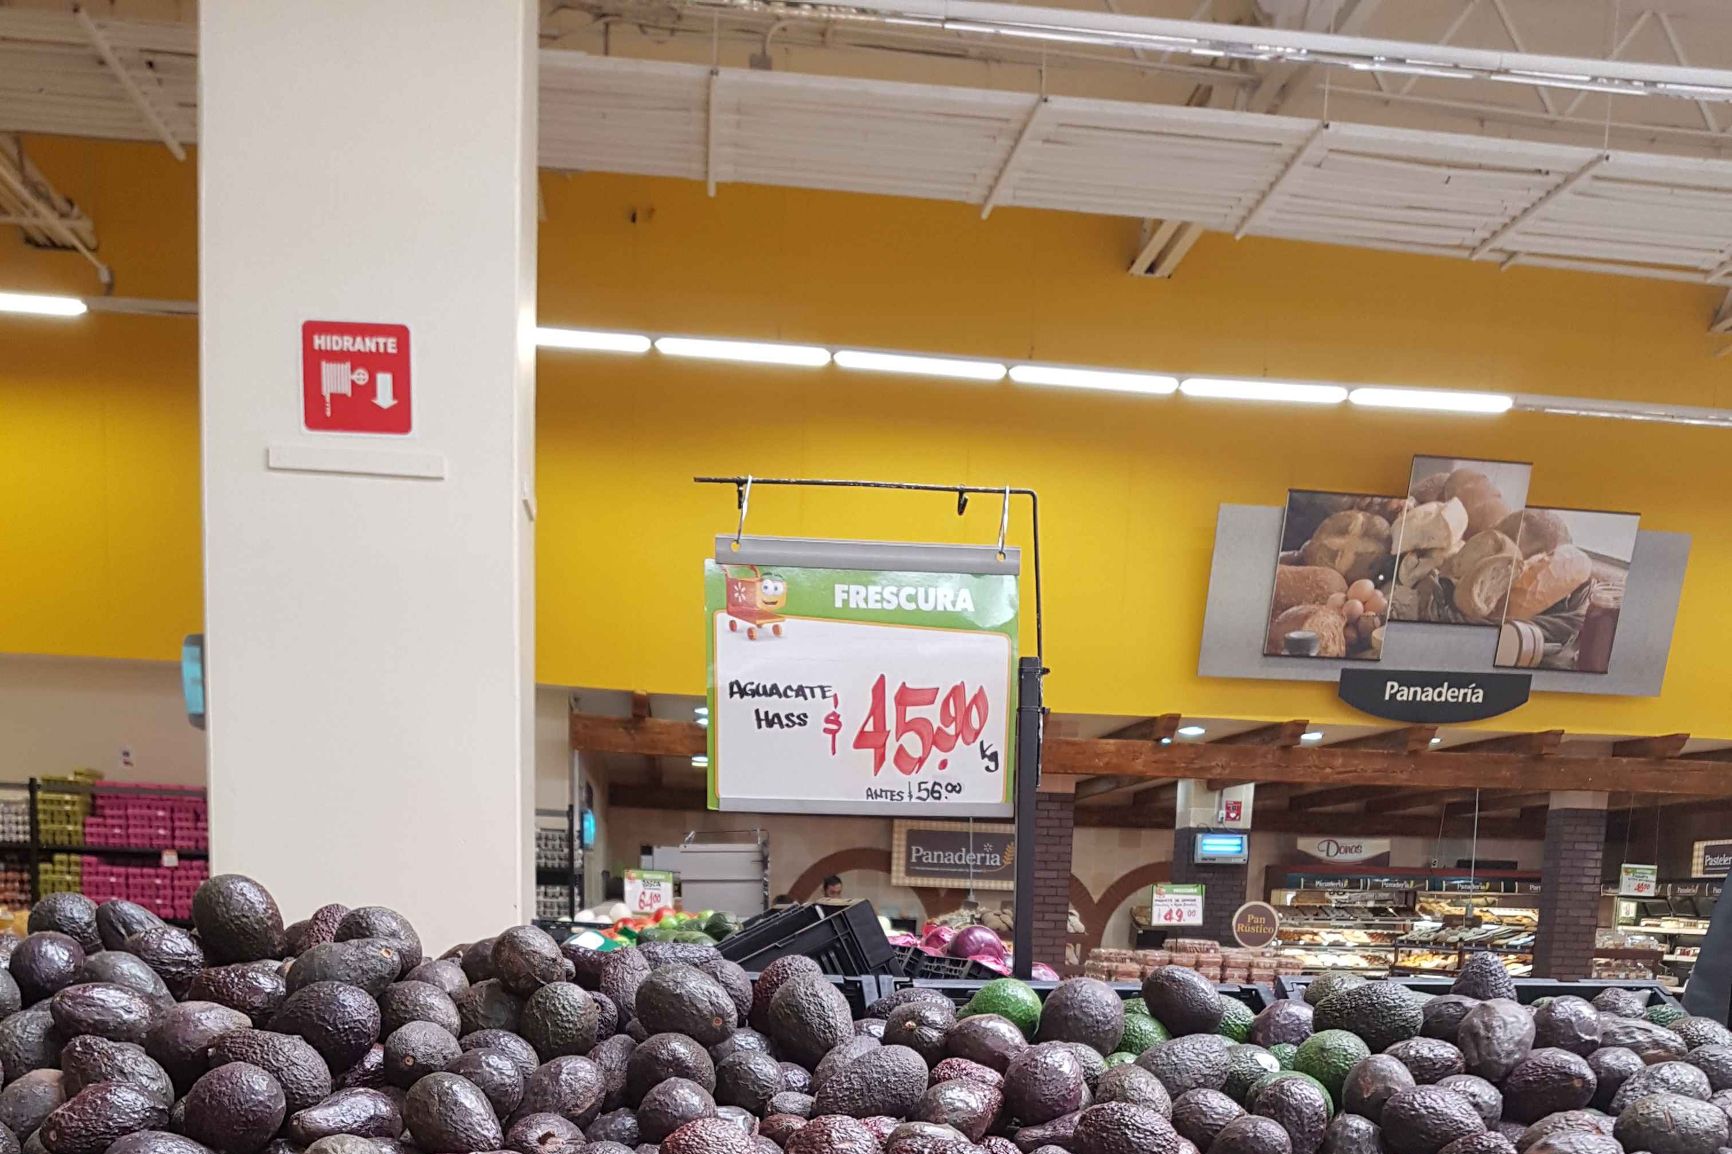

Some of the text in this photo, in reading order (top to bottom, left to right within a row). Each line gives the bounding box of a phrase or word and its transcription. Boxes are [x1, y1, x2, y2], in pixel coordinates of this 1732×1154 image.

[312, 334, 398, 354] HIDRANTE
[834, 584, 975, 612] FRESCURA
[728, 680, 834, 700] AGUACATE
[1384, 681, 1484, 703] Panadería
[754, 709, 809, 730] HASS
[866, 788, 904, 802] ANTES
[1247, 913, 1266, 924] Pan
